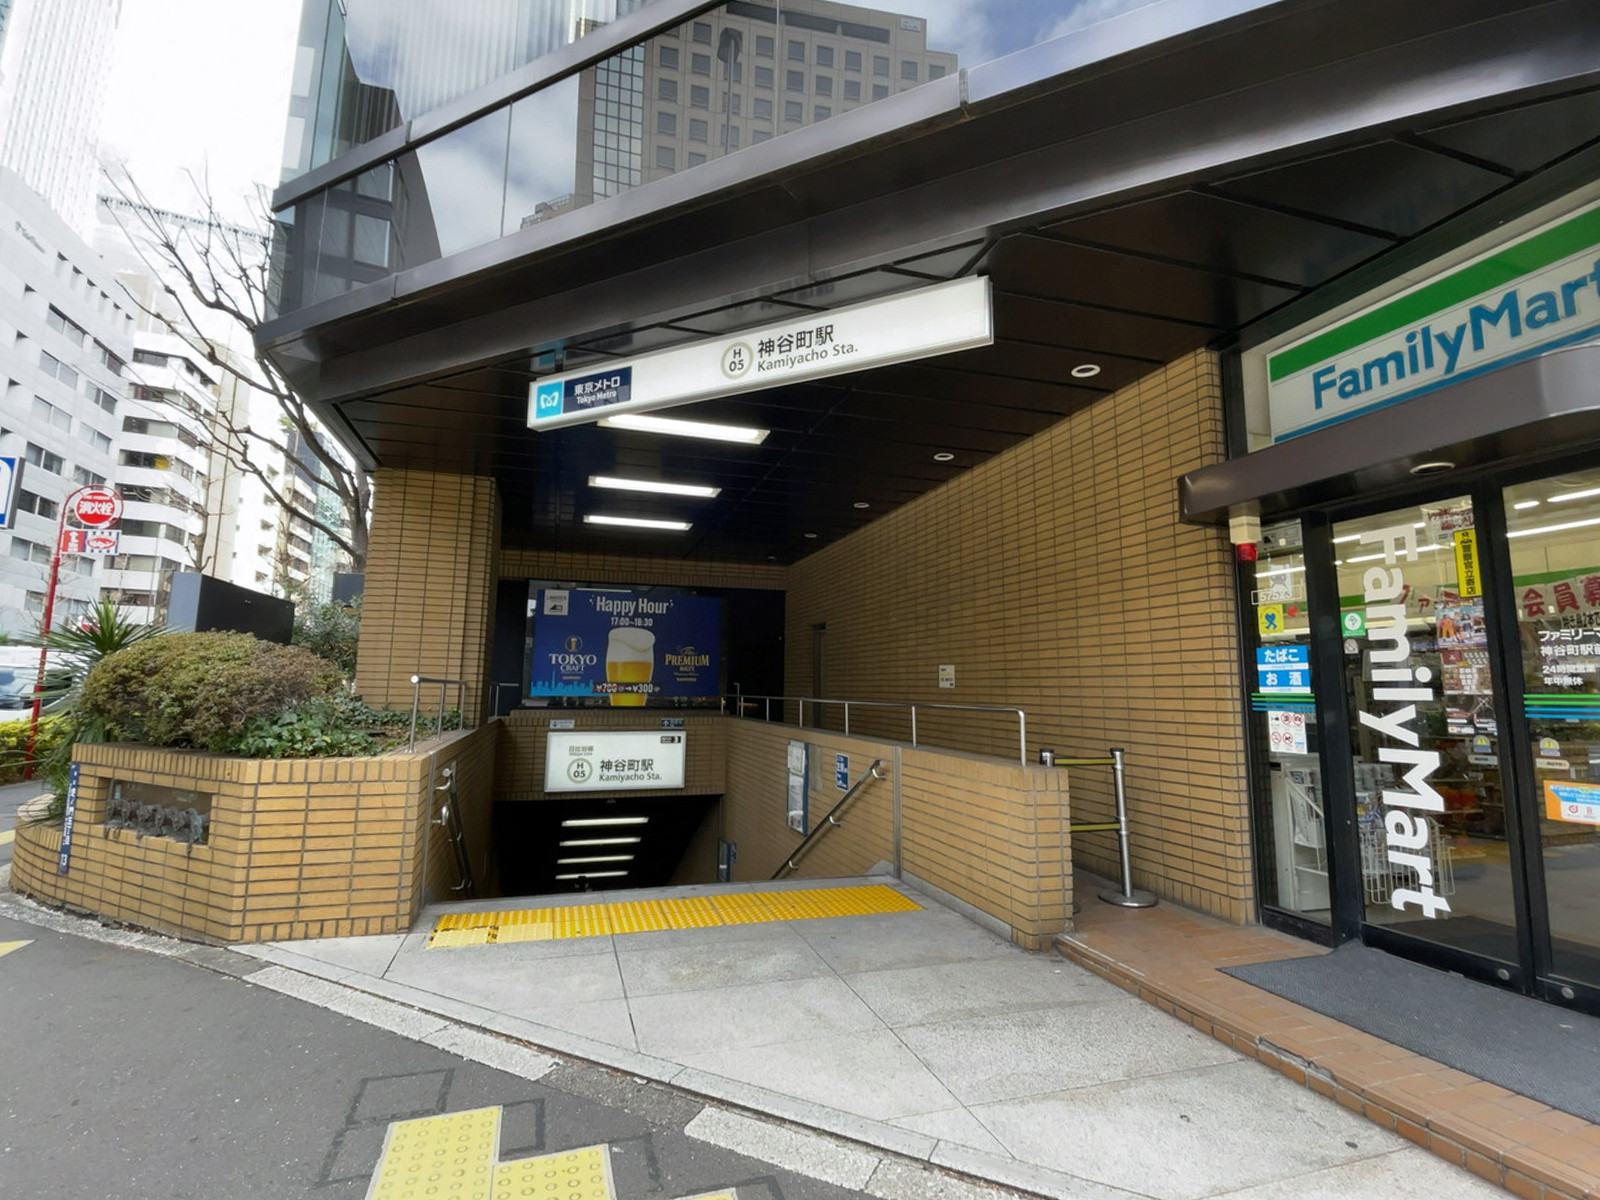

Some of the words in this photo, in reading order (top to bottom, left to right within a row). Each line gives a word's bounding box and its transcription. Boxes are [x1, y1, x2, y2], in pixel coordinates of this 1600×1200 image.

[758, 324, 834, 358] 神谷町駅
[733, 348, 742, 359] H
[758, 349, 828, 372] Kamiyacho
[832, 343, 858, 357] Sta.
[729, 360, 744, 372] 05
[574, 376, 620, 396] 東京メトロ
[576, 394, 595, 405] Tokyo
[596, 390, 617, 400] Metro
[79, 501, 113, 515] 消火栓
[596, 596, 636, 616] Happy
[638, 598, 669, 614] Hour
[548, 653, 597, 665] TOKYO
[665, 653, 709, 666] PREMIUM
[1264, 648, 1300, 663] たばこ
[1543, 676, 1583, 687] 年中無休
[1359, 525, 1452, 919] FamilyMart
[576, 762, 584, 770] H
[600, 759, 654, 772] 神谷町駅
[573, 770, 586, 778] 05
[599, 771, 645, 783] Kamiyacho
[647, 772, 662, 781] Sta.
